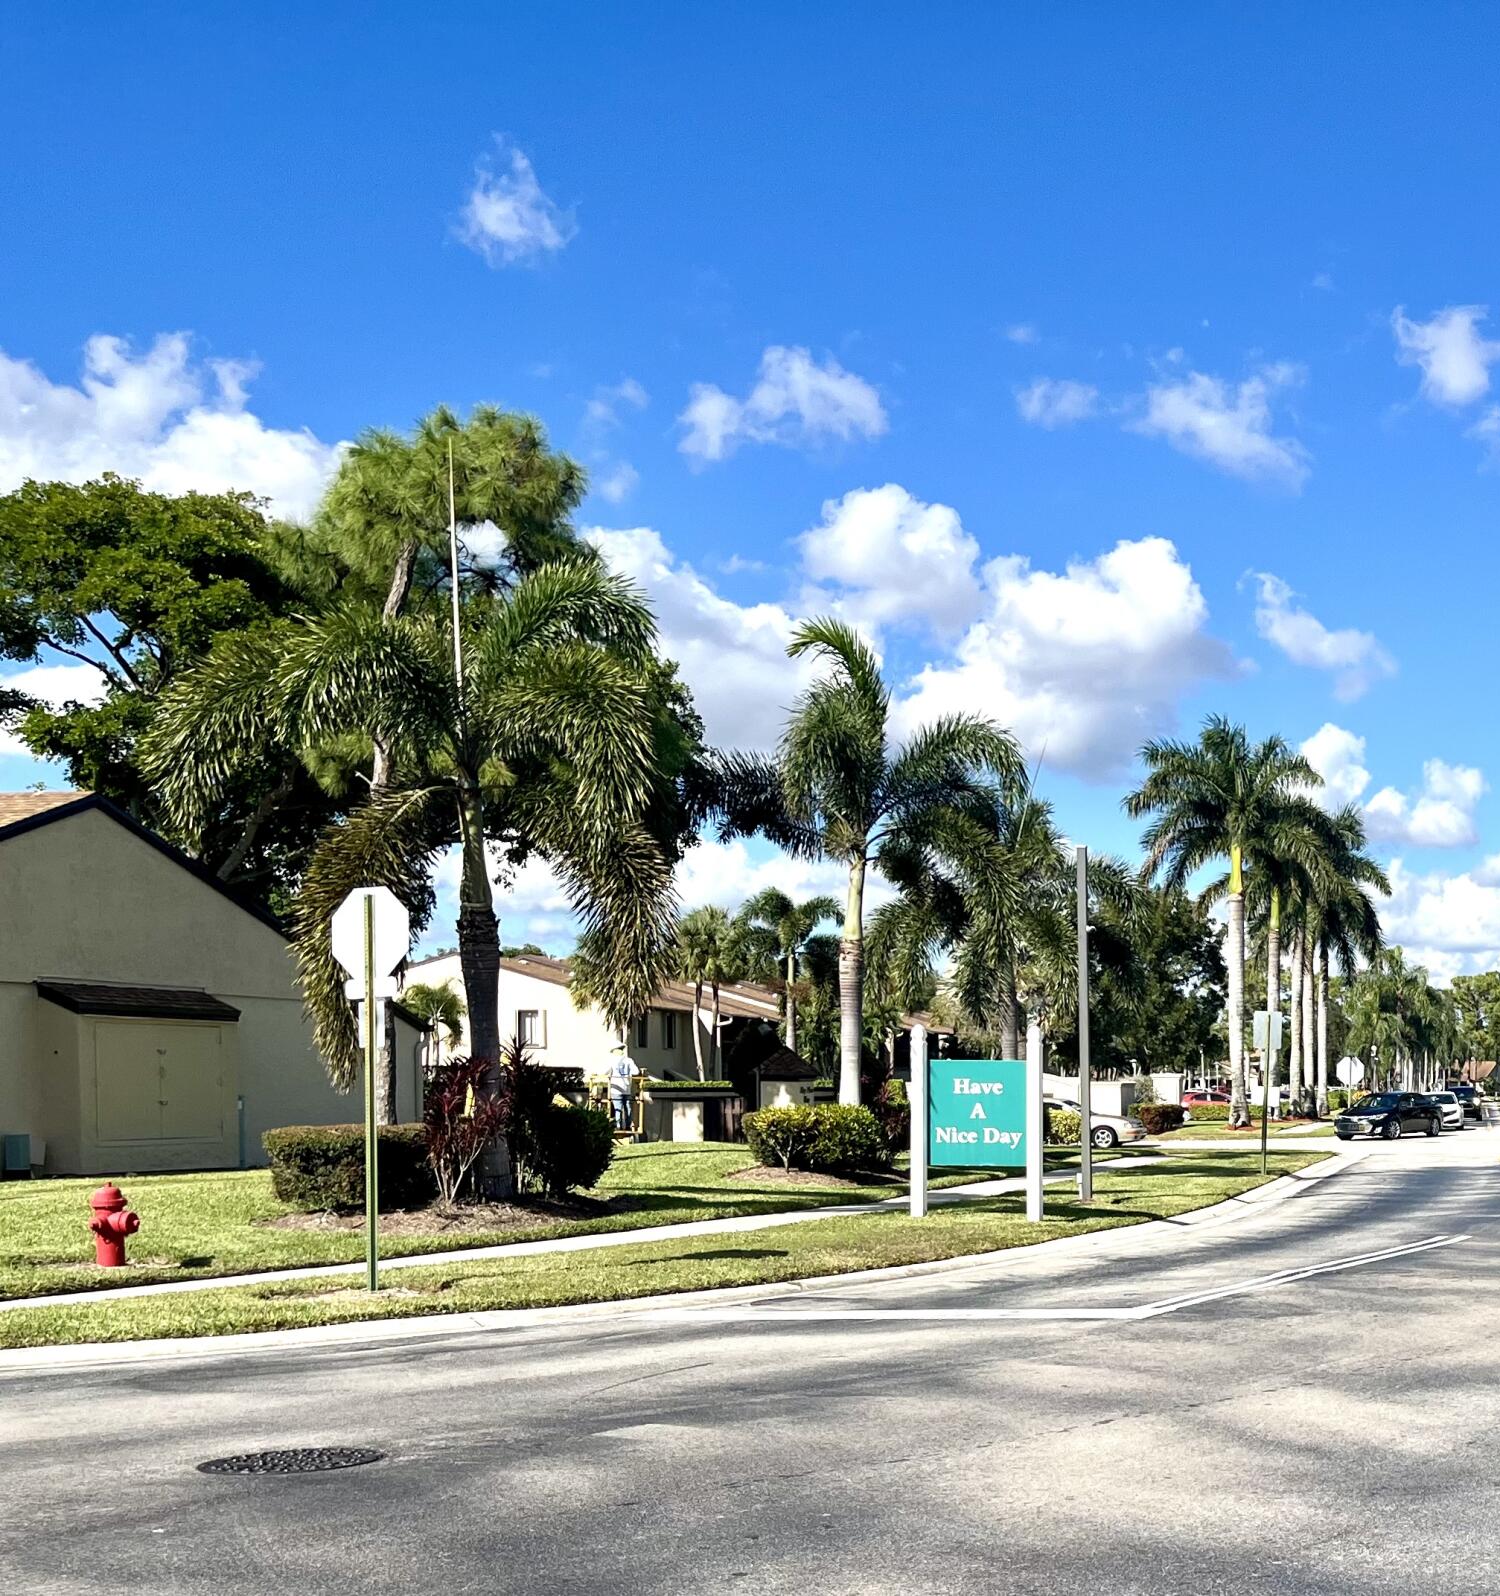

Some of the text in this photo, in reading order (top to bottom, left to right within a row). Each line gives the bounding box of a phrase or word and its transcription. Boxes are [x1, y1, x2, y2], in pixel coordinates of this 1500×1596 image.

[953, 1078, 1004, 1095] Have
[969, 1102, 987, 1119] A
[935, 1126, 1023, 1149] Nice Day
